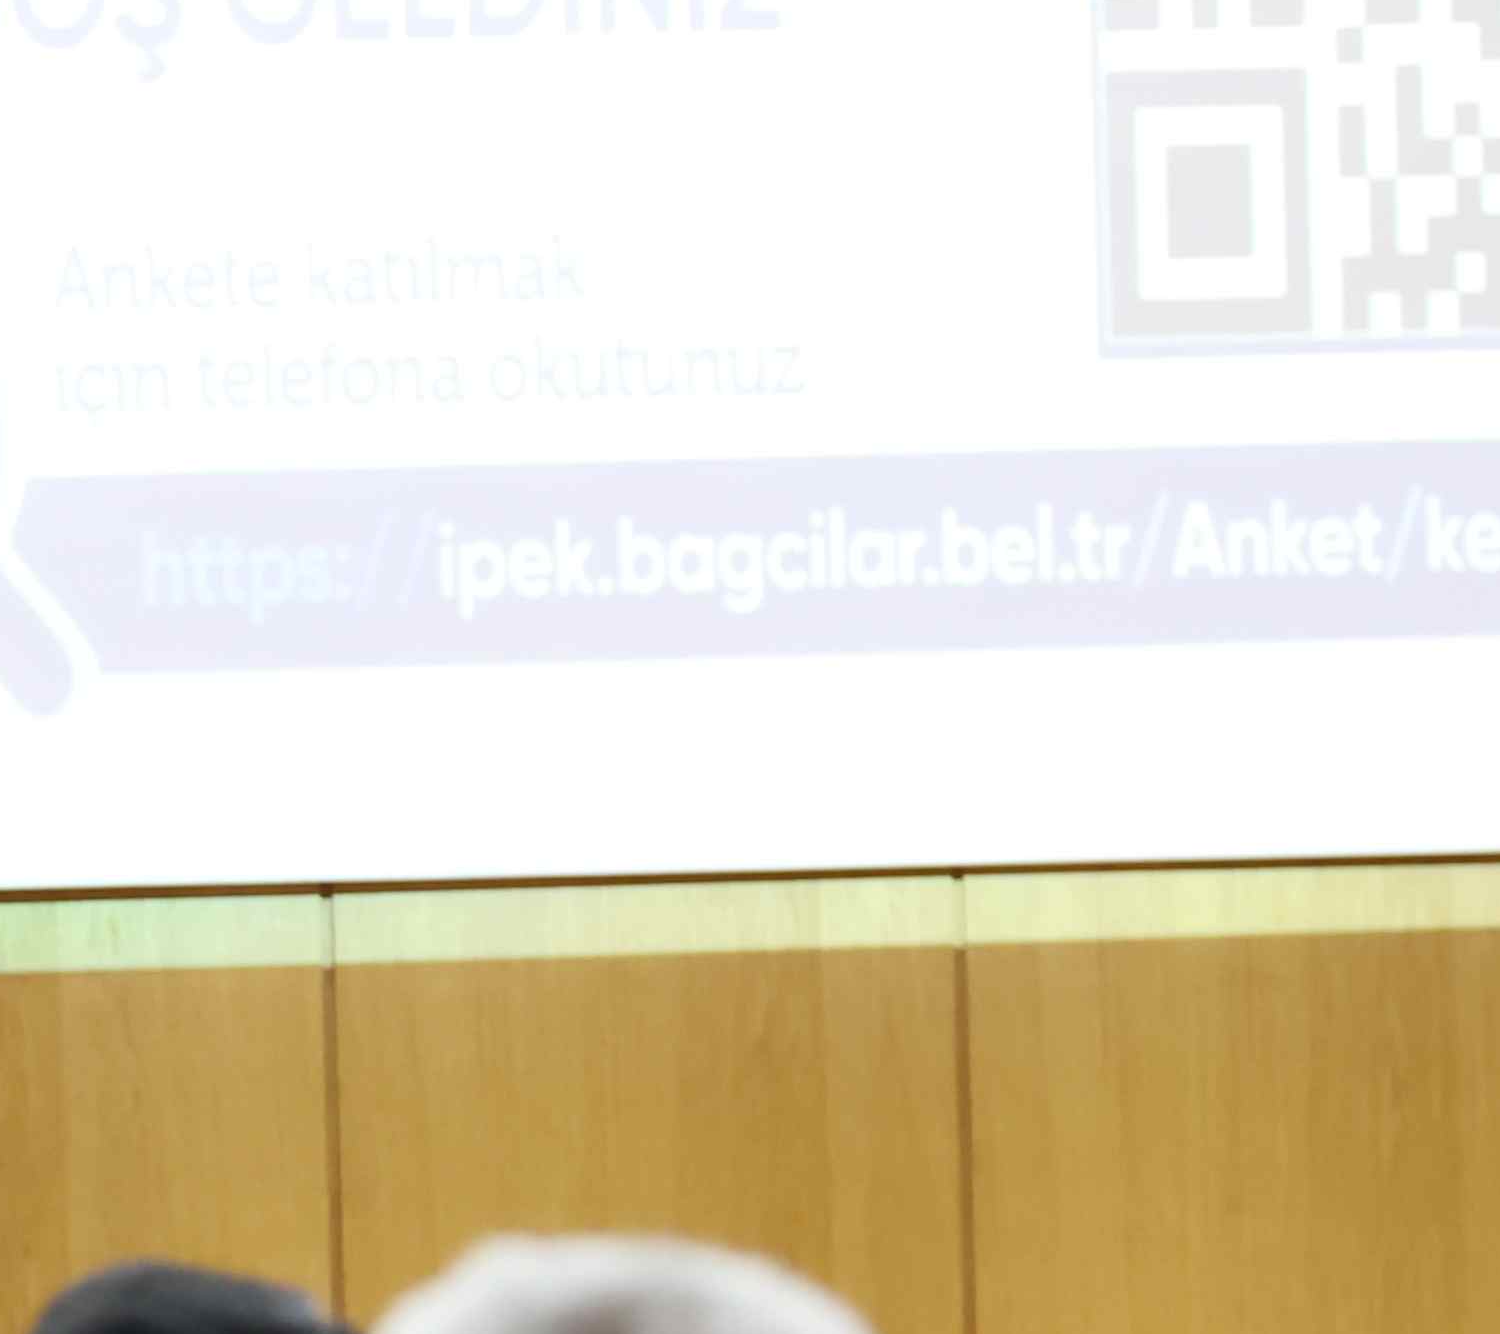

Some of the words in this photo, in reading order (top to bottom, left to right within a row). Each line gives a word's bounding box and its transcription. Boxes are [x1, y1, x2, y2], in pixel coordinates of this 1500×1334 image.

[56, 244, 281, 310] Ankete
[199, 341, 466, 409] telefona
[488, 334, 808, 405] okutunuz
